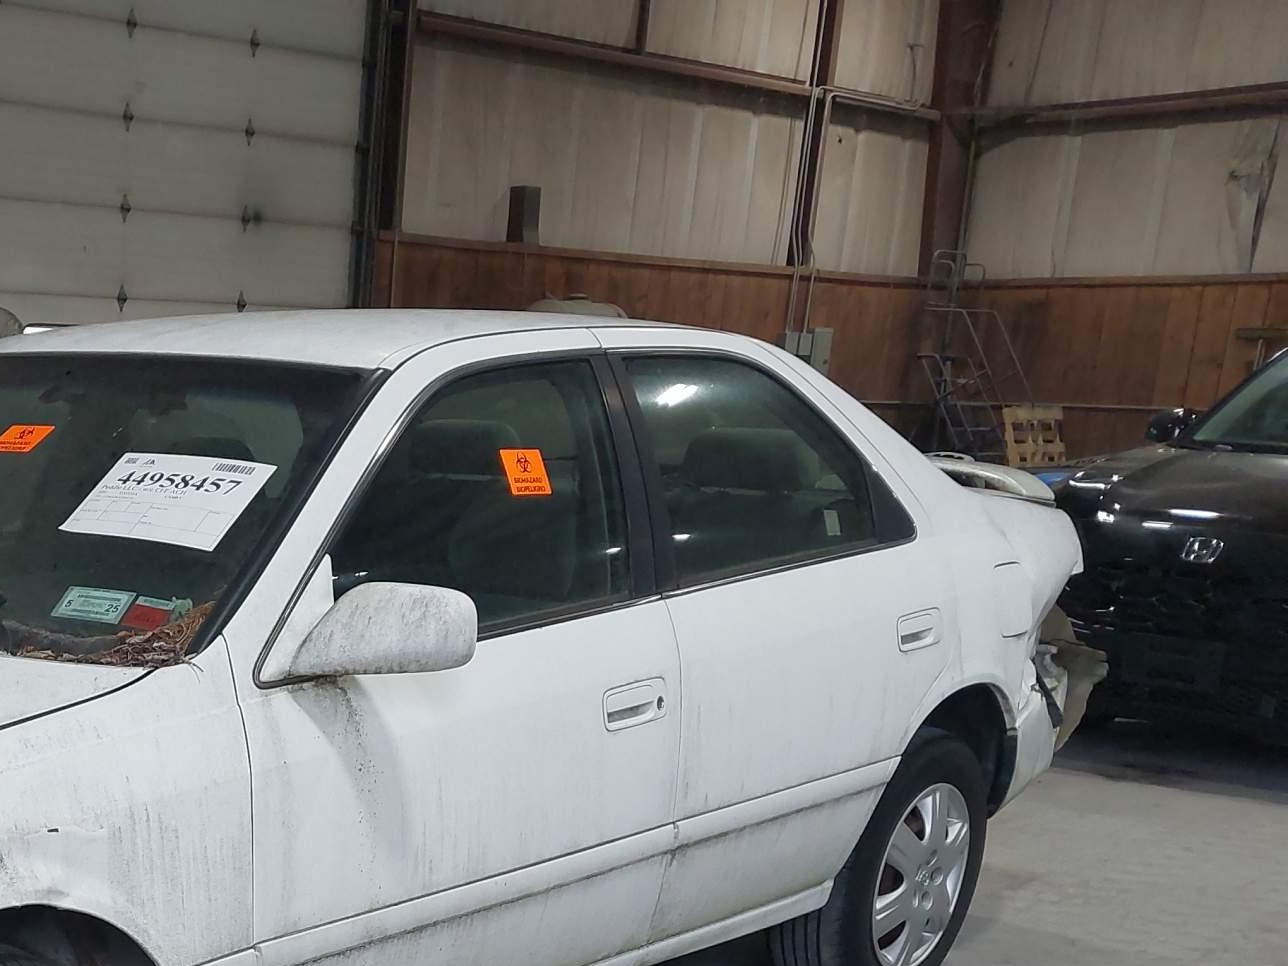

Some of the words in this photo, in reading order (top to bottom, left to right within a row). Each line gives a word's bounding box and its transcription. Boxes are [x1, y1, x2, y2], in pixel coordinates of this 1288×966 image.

[117, 470, 243, 496] 44958457
[65, 599, 74, 608] 5
[103, 604, 121, 613] 25
